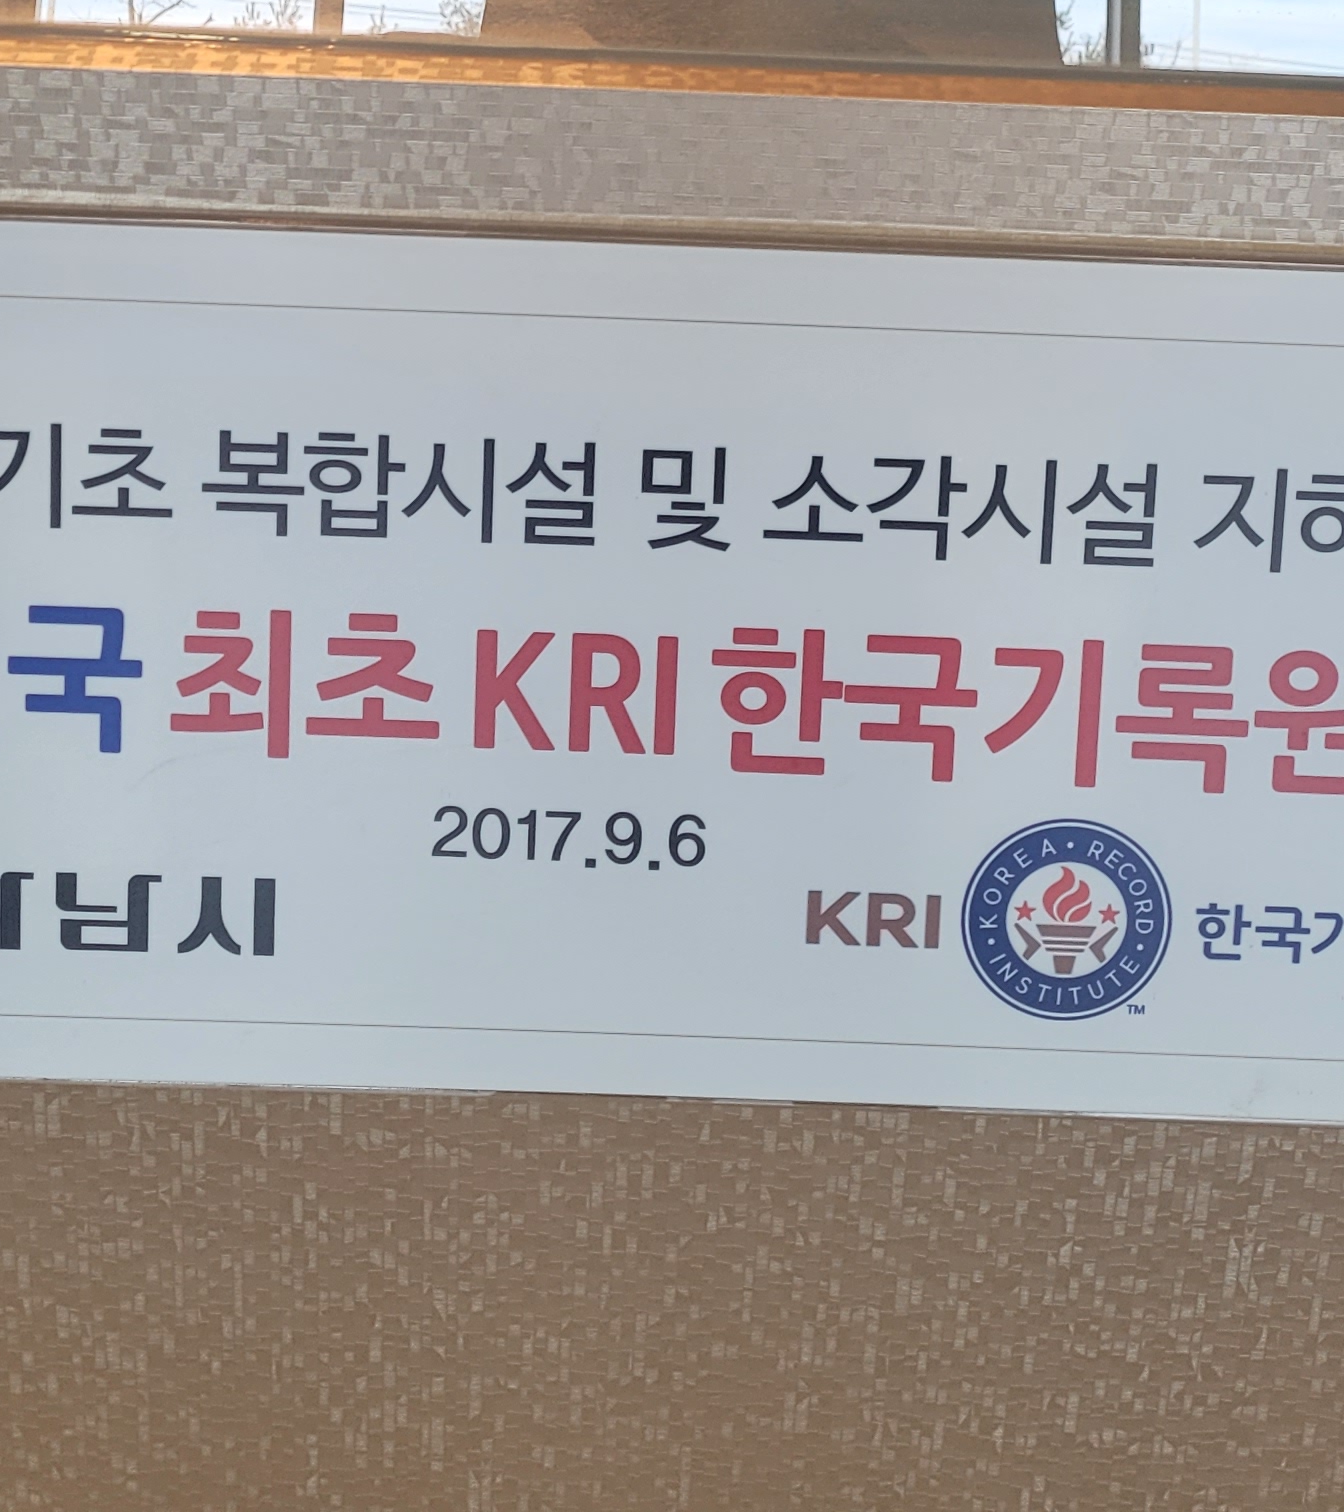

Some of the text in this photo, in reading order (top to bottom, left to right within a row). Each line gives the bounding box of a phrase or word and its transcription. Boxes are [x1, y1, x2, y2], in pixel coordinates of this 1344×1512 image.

[201, 429, 597, 547] 복합시설
[641, 446, 731, 552] 및
[762, 455, 1158, 568] 소각시설
[168, 606, 442, 761] 최초
[471, 627, 679, 758] KRI
[431, 805, 707, 871] 2017.9.6
[805, 889, 942, 950] KRI
[978, 839, 1154, 936] KOREA RECORD
[988, 955, 1140, 1006] INSTITUTE
[1127, 1004, 1145, 1016] TM
